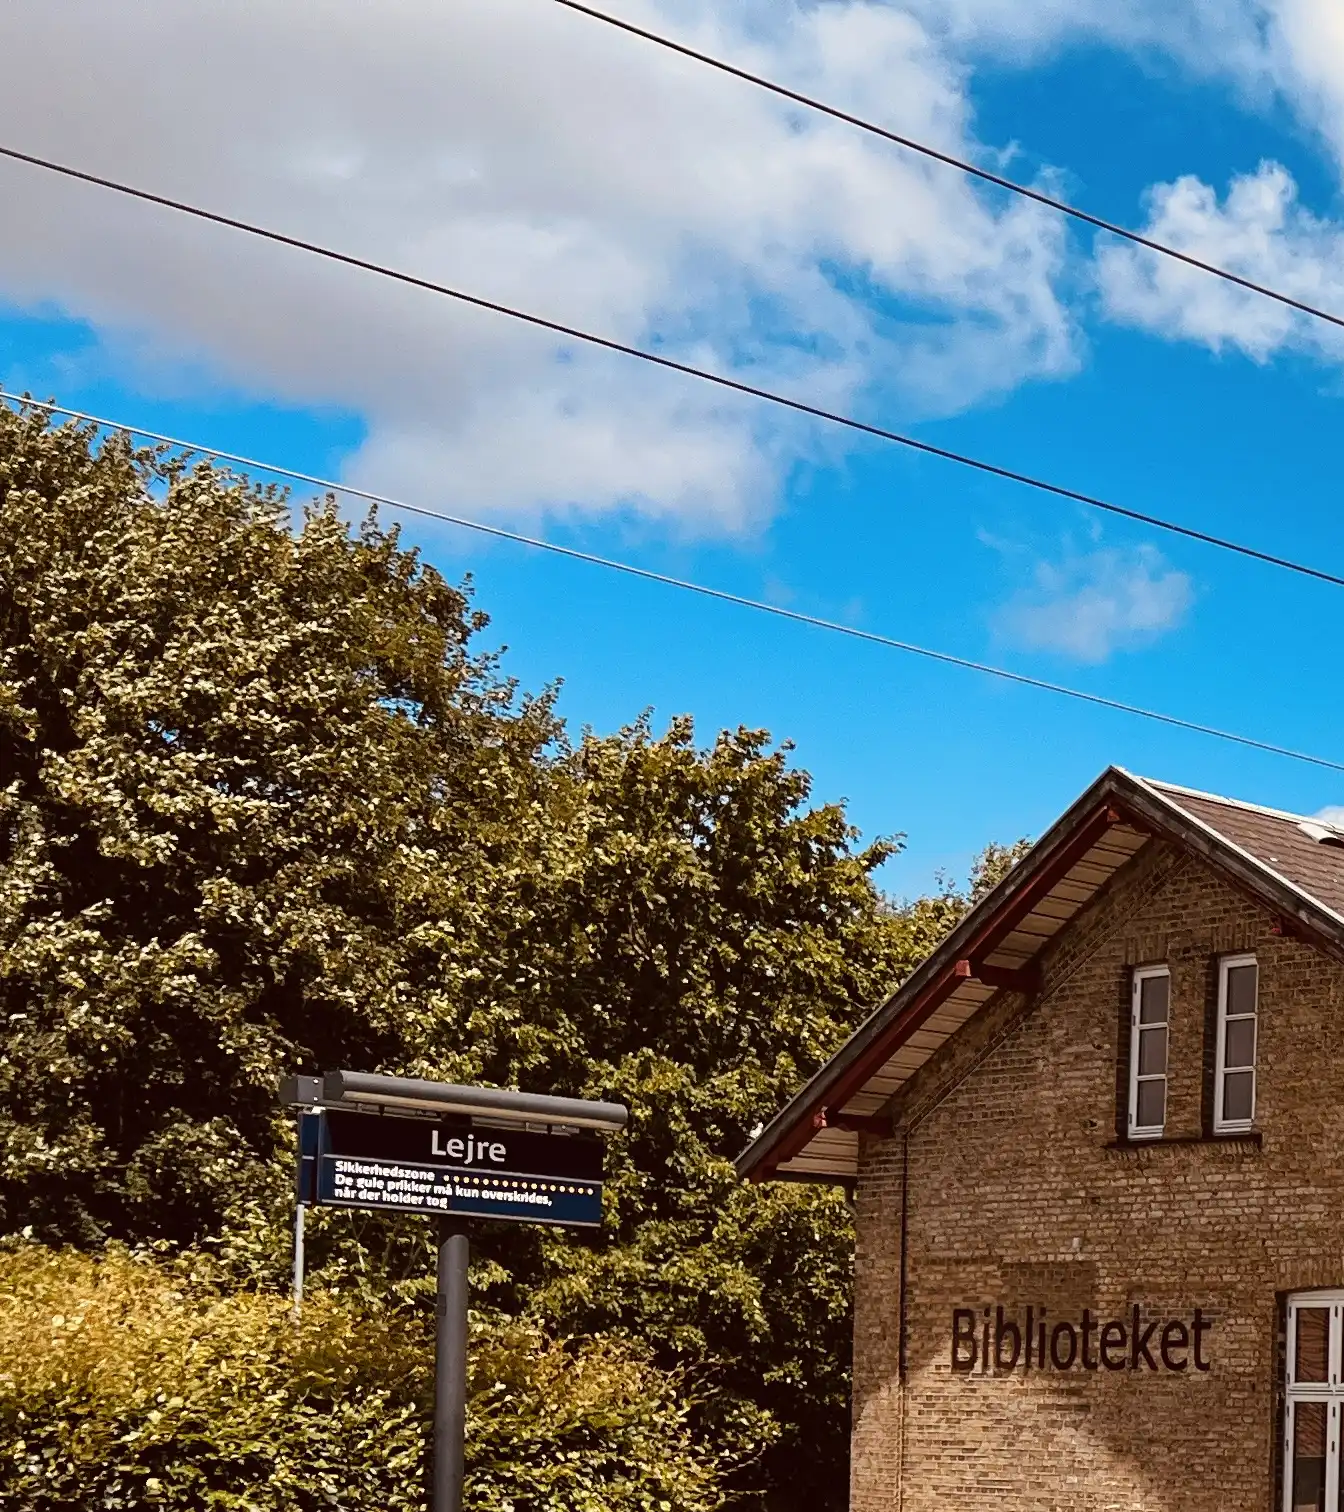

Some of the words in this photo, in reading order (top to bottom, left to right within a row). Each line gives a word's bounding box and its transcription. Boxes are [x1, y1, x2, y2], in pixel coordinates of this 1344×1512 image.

[431, 1129, 507, 1164] Lejre
[335, 1160, 436, 1182] Sikkerhedszone
[334, 1186, 357, 1199] når
[358, 1188, 381, 1201] der
[382, 1189, 424, 1205] holder
[426, 1196, 448, 1209] tog
[335, 1174, 353, 1186] De
[357, 1176, 384, 1190] gule
[387, 1179, 432, 1193] prikker
[433, 1184, 453, 1196] må
[455, 1184, 479, 1198] kun
[481, 1189, 553, 1206] overskrides,
[951, 1303, 1212, 1373] Biblioteket
